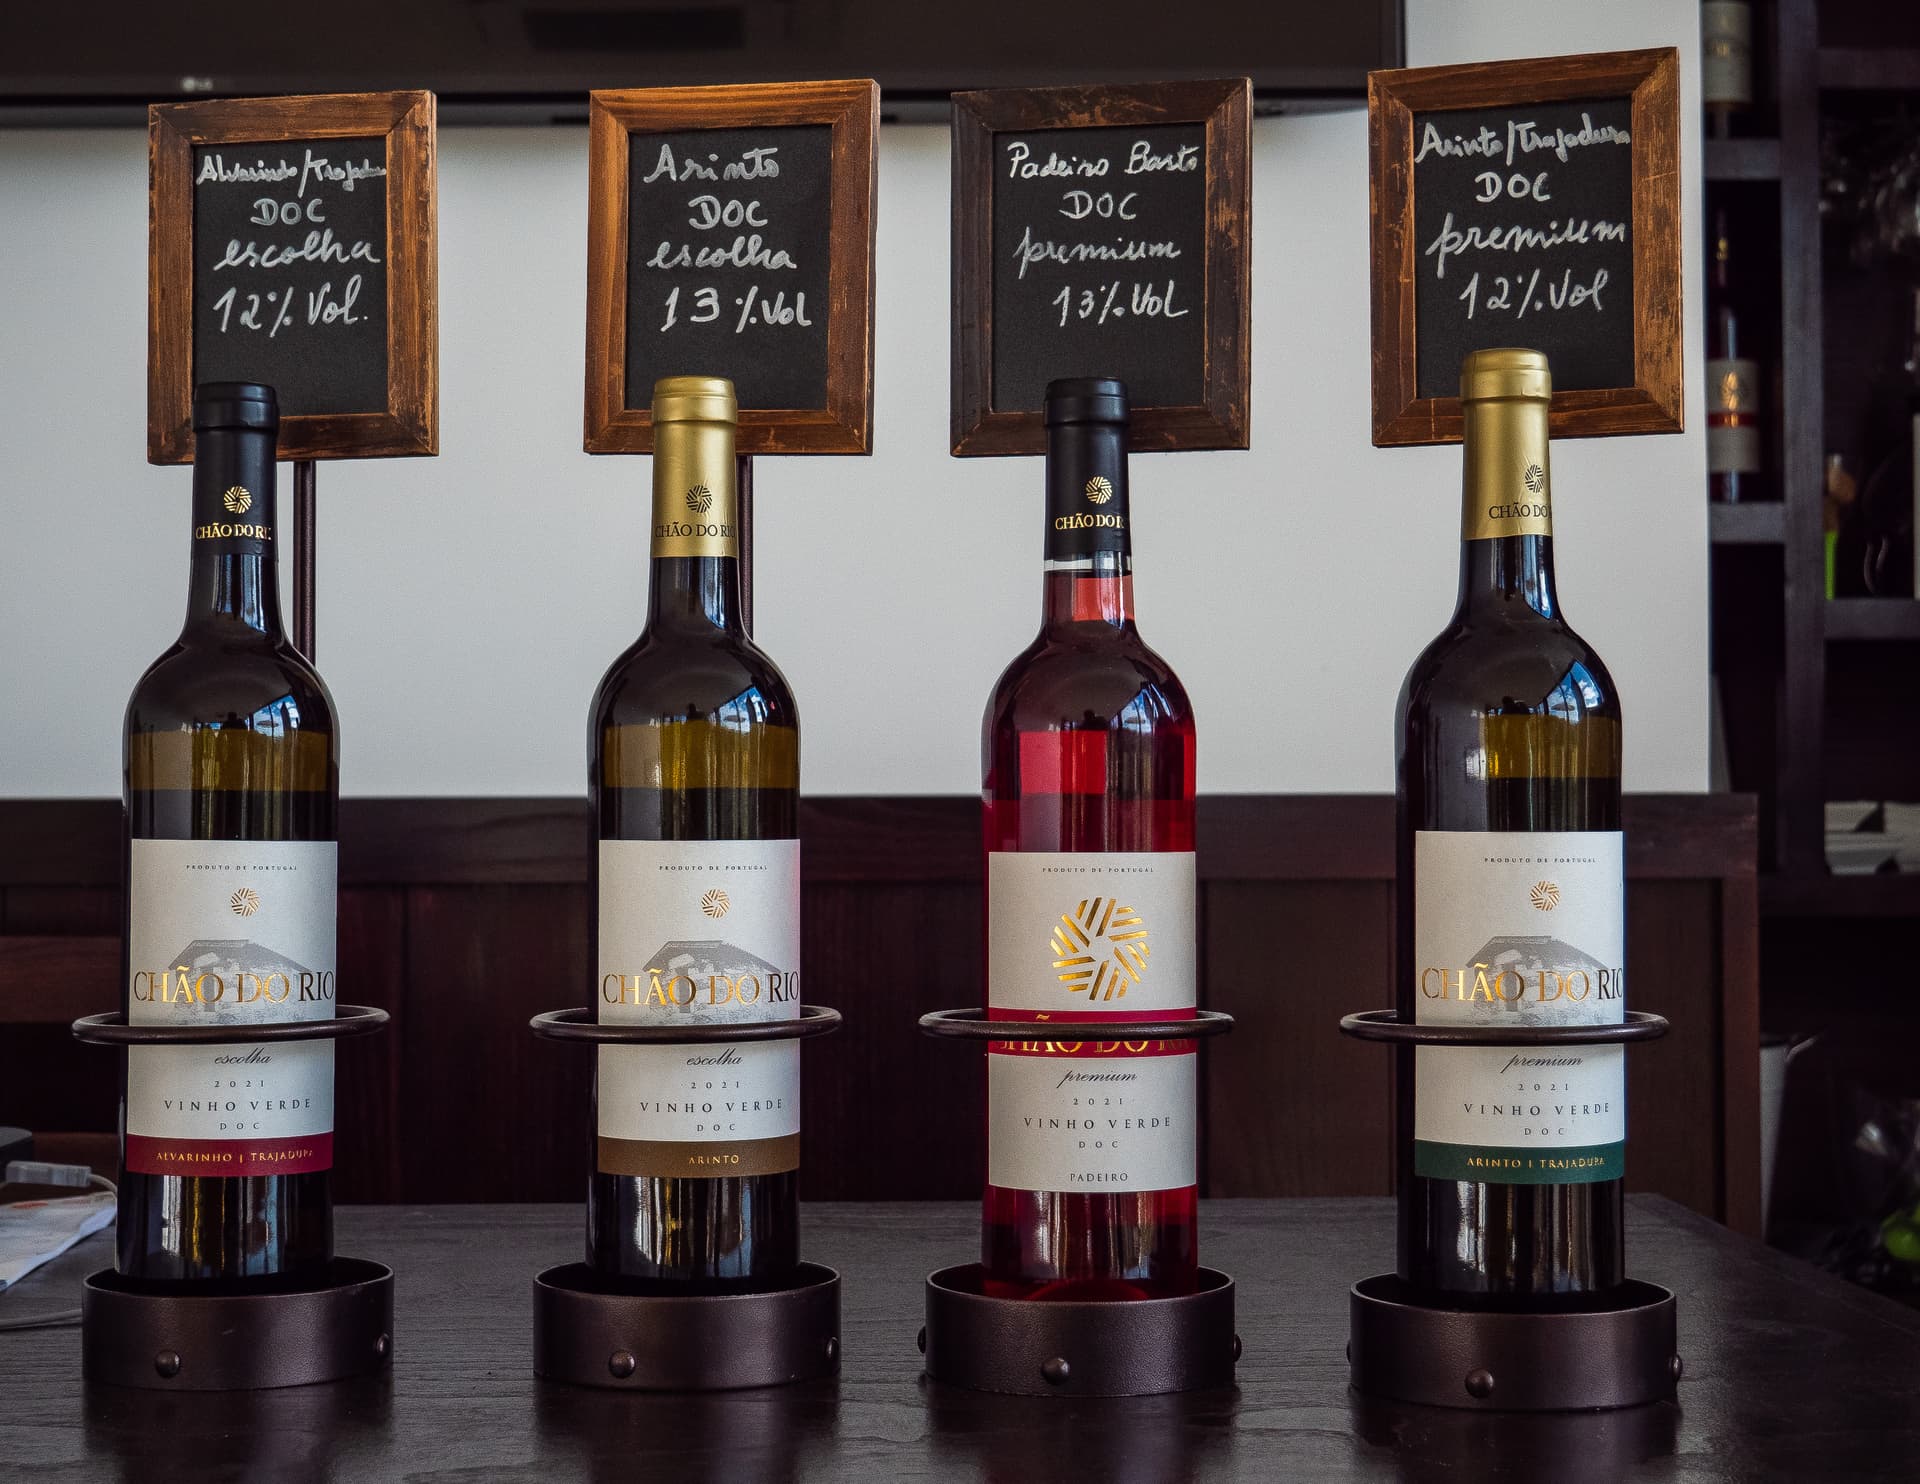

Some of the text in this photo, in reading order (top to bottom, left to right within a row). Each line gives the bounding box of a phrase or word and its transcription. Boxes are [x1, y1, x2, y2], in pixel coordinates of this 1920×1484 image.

[643, 143, 780, 183] Arinto
[1007, 140, 1200, 179] Padeiro Basto
[1474, 171, 1551, 203] DOC
[250, 198, 326, 226] DOC
[688, 195, 769, 230] DOC
[1058, 190, 1138, 220] DOC
[213, 228, 381, 271] escolha
[647, 234, 797, 269] escolha
[1012, 226, 1182, 279] premium
[1425, 212, 1626, 279] premium
[1488, 502, 1531, 519] CHÃO
[1533, 504, 1548, 518] DO
[655, 521, 692, 538] CHÃO
[696, 524, 718, 537] DO
[1055, 512, 1094, 530] CHÃO
[1096, 514, 1115, 528] DO
[195, 522, 233, 540] CHÃO
[234, 523, 254, 537] DO
[185, 864, 231, 872] PRODUTO
[133, 965, 335, 1004] CHÃO DO RIO
[603, 968, 799, 1007] CHÃO DO RIO
[1421, 962, 1525, 1002] CHÃO
[1536, 969, 1591, 1002] DO
[214, 1047, 272, 1065] escolha
[686, 1047, 743, 1066] escolha
[1500, 1054, 1584, 1074] premium
[214, 1080, 265, 1088] 2021
[691, 1081, 740, 1089] 2021
[1056, 1070, 1137, 1089] premium
[1517, 1083, 1569, 1091] 2021
[164, 1098, 311, 1112] VINHO VERDE
[640, 1098, 782, 1113] VINHO VERDE
[1073, 1097, 1123, 1106] 2021
[1464, 1102, 1609, 1116] VINHO VERDE
[219, 1122, 260, 1130] DOC
[697, 1123, 736, 1132] DOC
[1024, 1116, 1171, 1130] VINHO VERDE
[1524, 1127, 1565, 1136] DOC
[1078, 1140, 1119, 1149] DOC
[156, 1152, 233, 1162] ALVARINHO
[688, 1154, 740, 1164] ARINTO
[1467, 1157, 1521, 1168] ARINTO
[1070, 1172, 1129, 1182] PADEIRO
